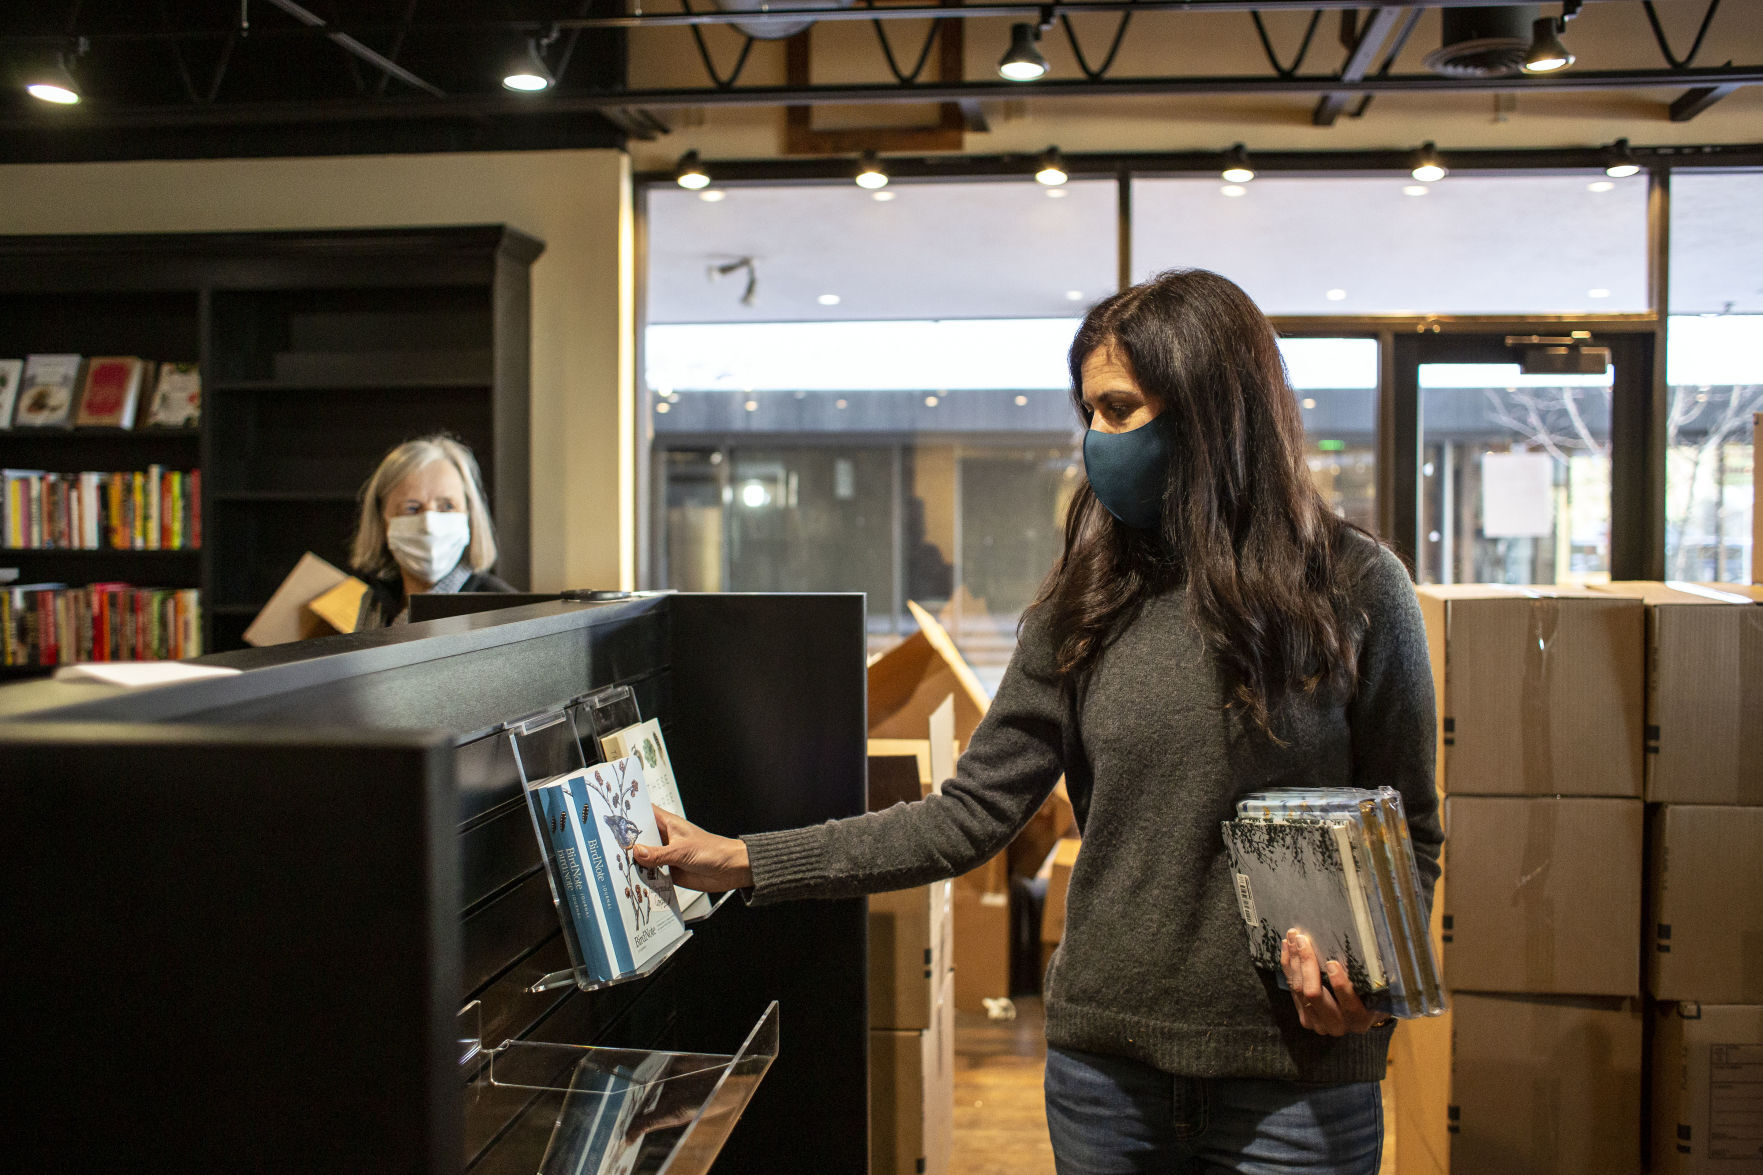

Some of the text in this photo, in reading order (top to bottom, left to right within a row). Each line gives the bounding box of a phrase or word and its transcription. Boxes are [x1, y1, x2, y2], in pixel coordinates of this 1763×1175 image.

[566, 846, 590, 918] BirdNote JOURNAL
[588, 839, 612, 910] BirdNote JOURNAL
[634, 926, 657, 948] BirdNote
